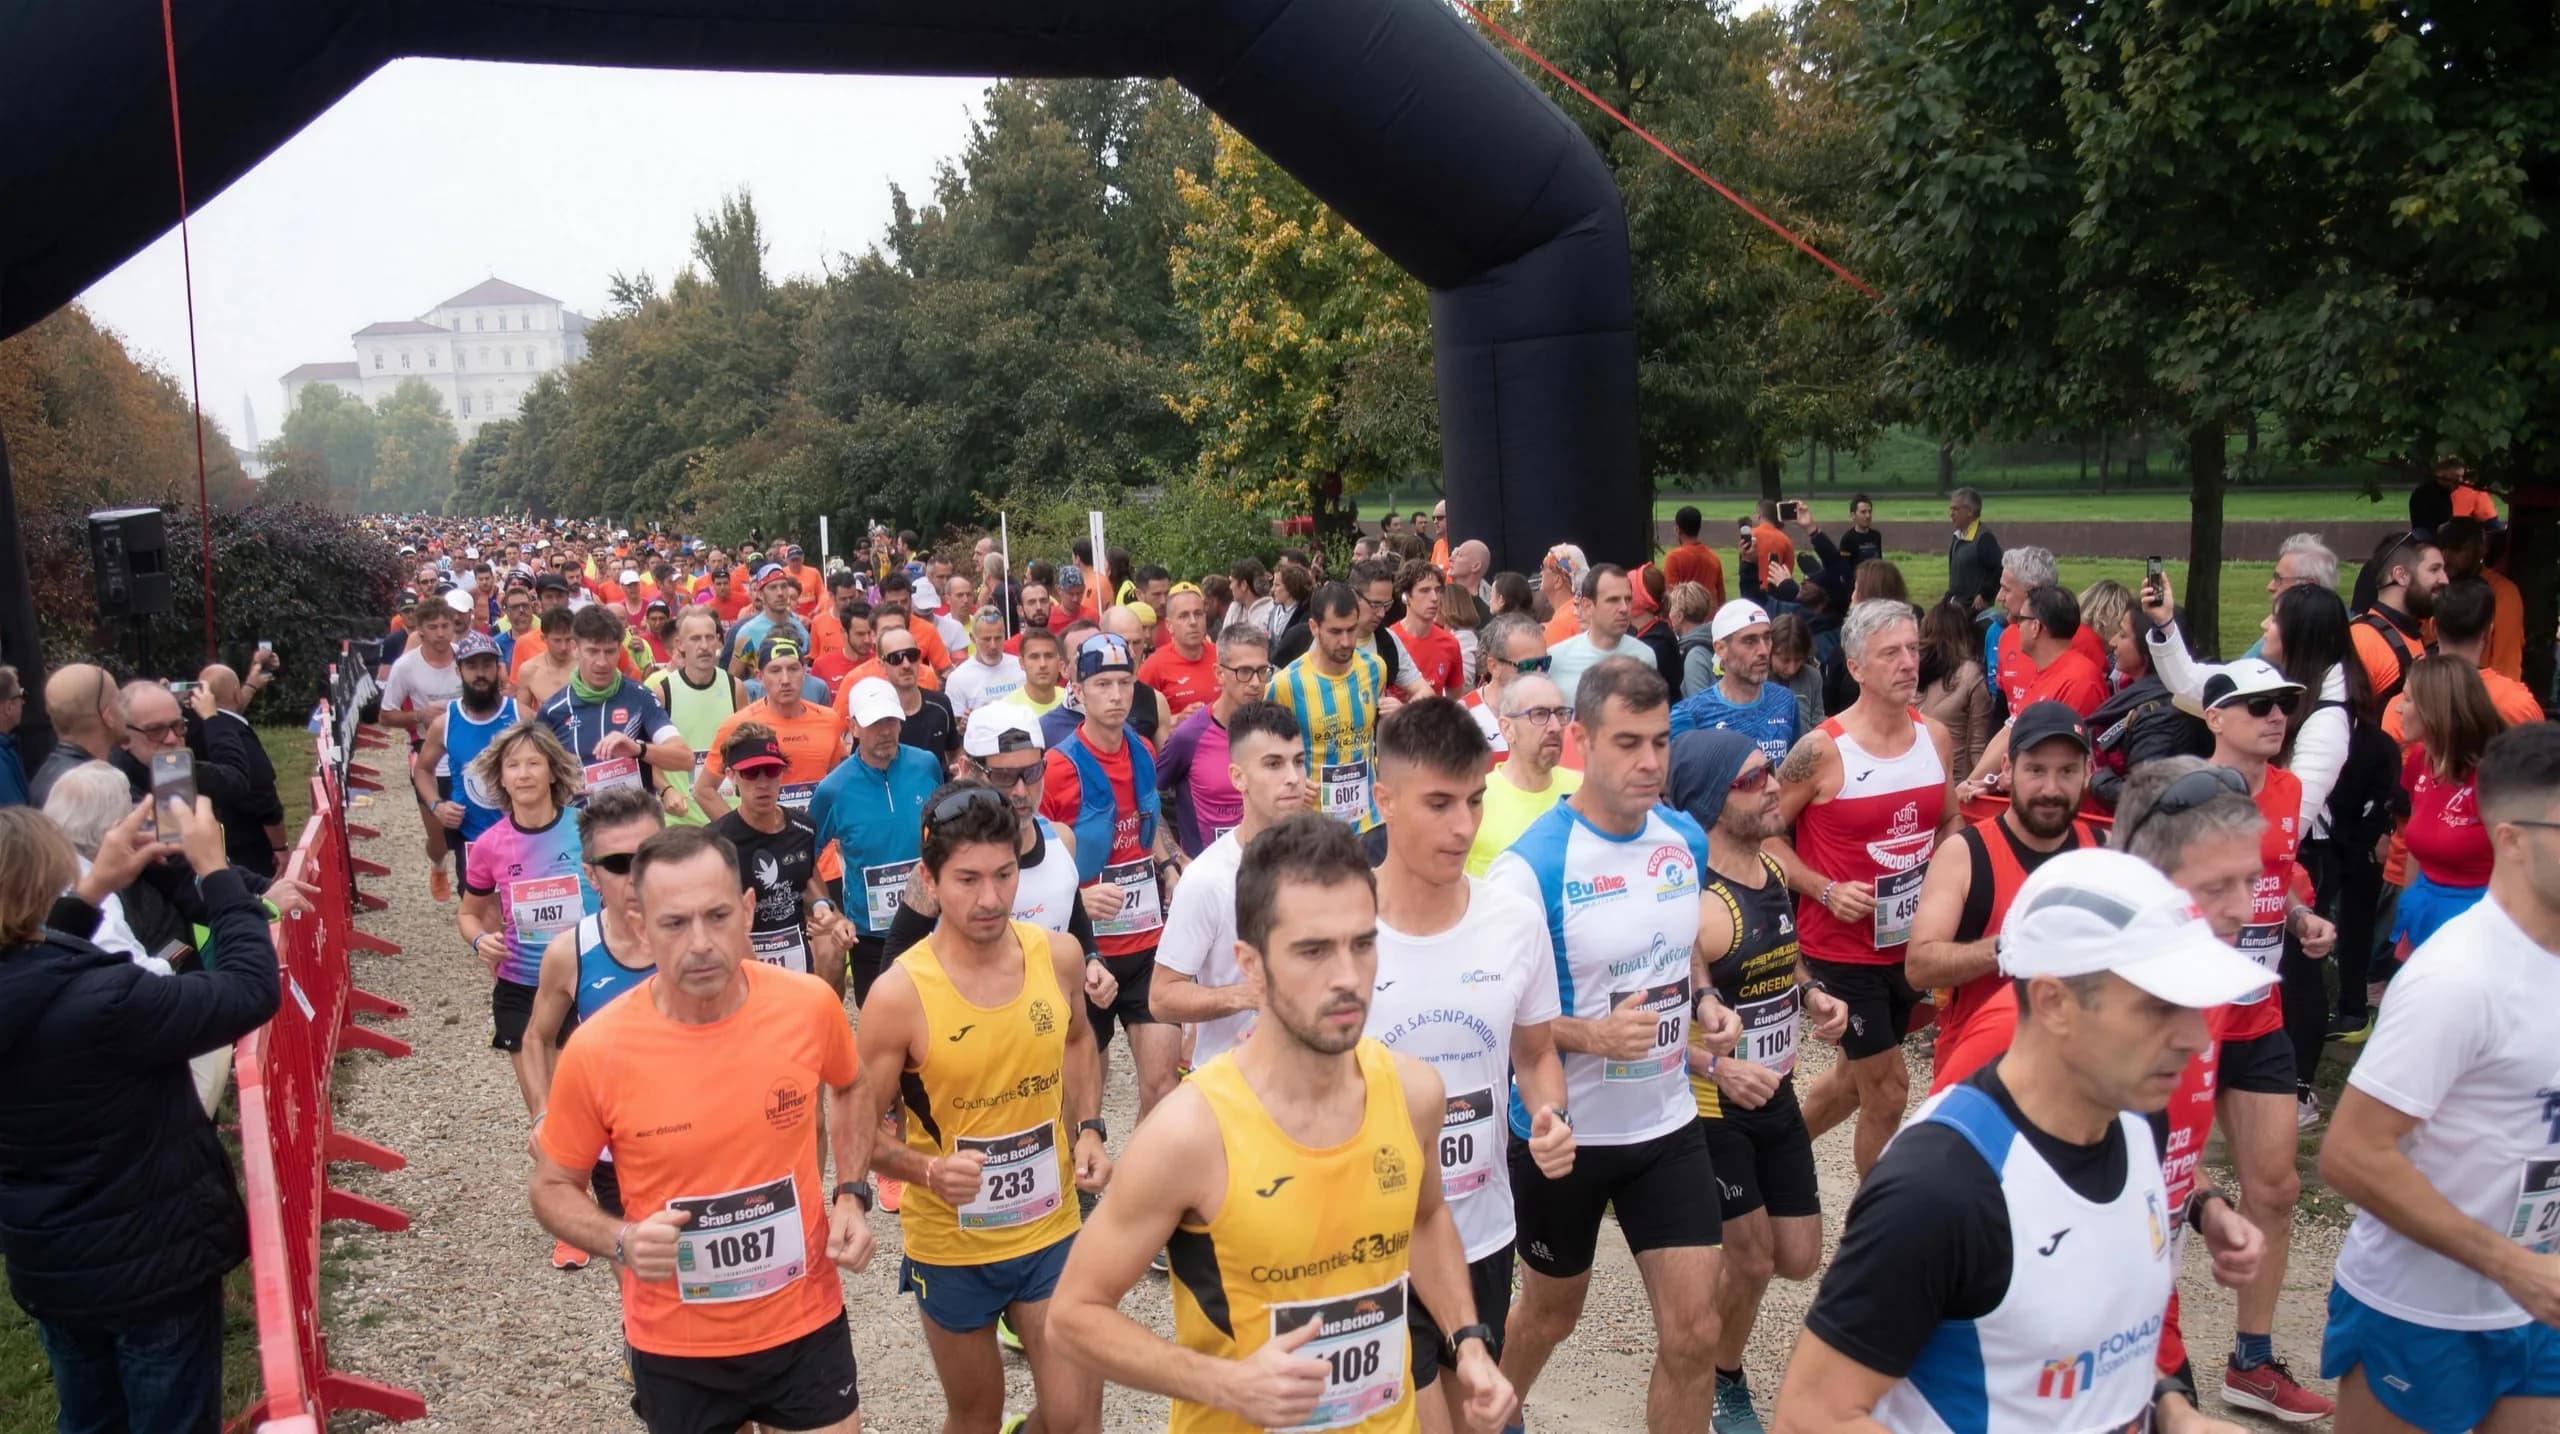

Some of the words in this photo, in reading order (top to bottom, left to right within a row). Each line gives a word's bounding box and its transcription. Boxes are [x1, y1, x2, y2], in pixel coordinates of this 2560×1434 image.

[1756, 1024, 1791, 1059] 1104
[1440, 1133, 1473, 1167] 60
[988, 1167, 1035, 1202] 233
[705, 1226, 775, 1269] 1087
